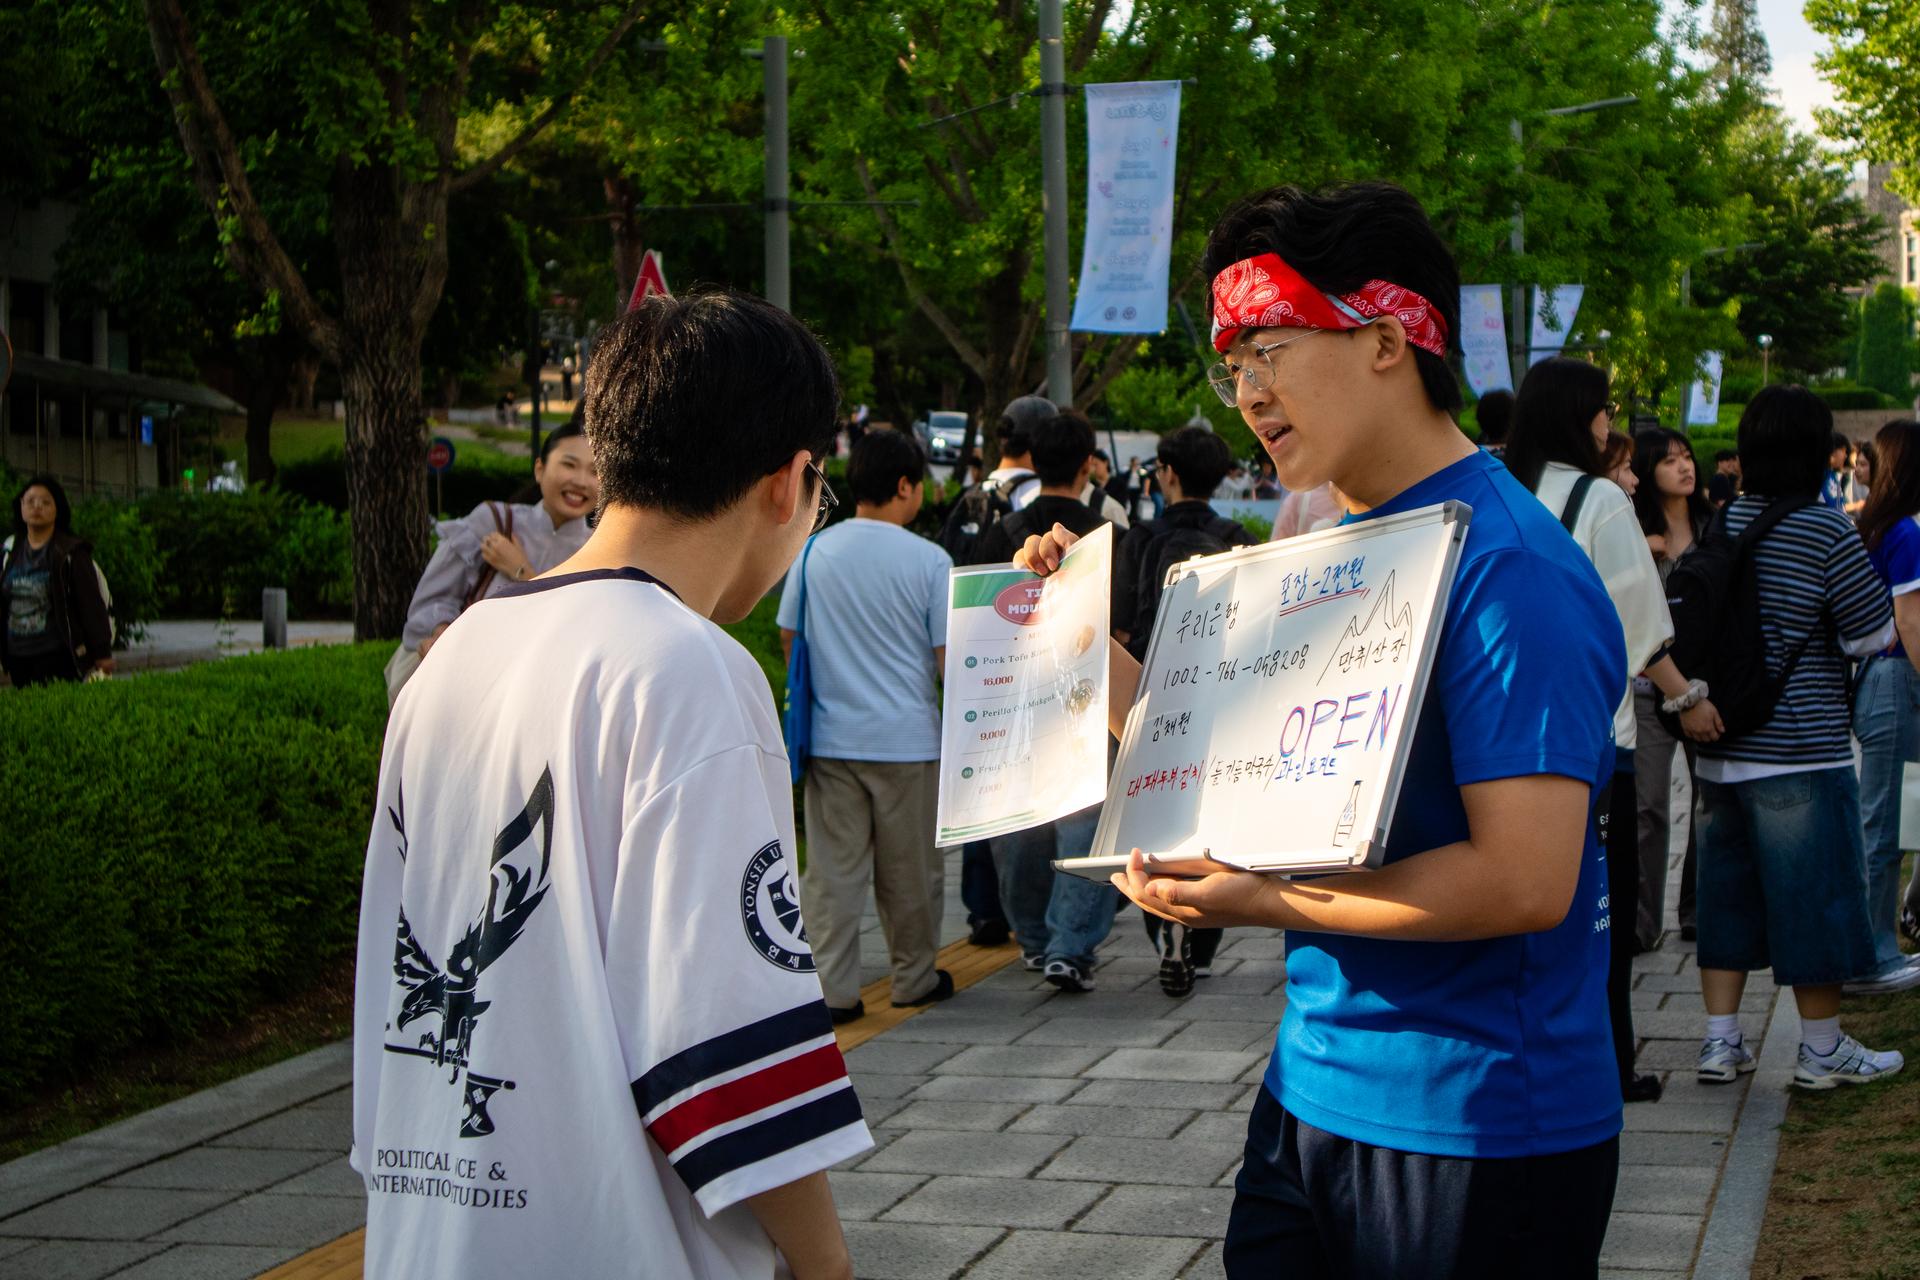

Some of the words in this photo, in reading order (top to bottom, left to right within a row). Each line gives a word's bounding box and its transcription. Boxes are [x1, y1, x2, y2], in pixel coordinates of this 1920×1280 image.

[1007, 603, 1038, 615] MOU
[1176, 600, 1240, 644] 우리은행
[983, 657, 1006, 665] Pork
[1338, 631, 1407, 674] 만취산장
[983, 675, 1014, 687] 16,000
[982, 707, 1012, 718] Perilla
[1013, 703, 1026, 713] Ol
[1280, 684, 1402, 758] OPEN
[980, 729, 1006, 741] 9,000
[1152, 711, 1192, 742] 김채원
[744, 858, 768, 919] YONSEI
[377, 1149, 451, 1172] POLITICAL
[488, 1161, 508, 1181] &
[451, 1181, 528, 1209] TUDIES
